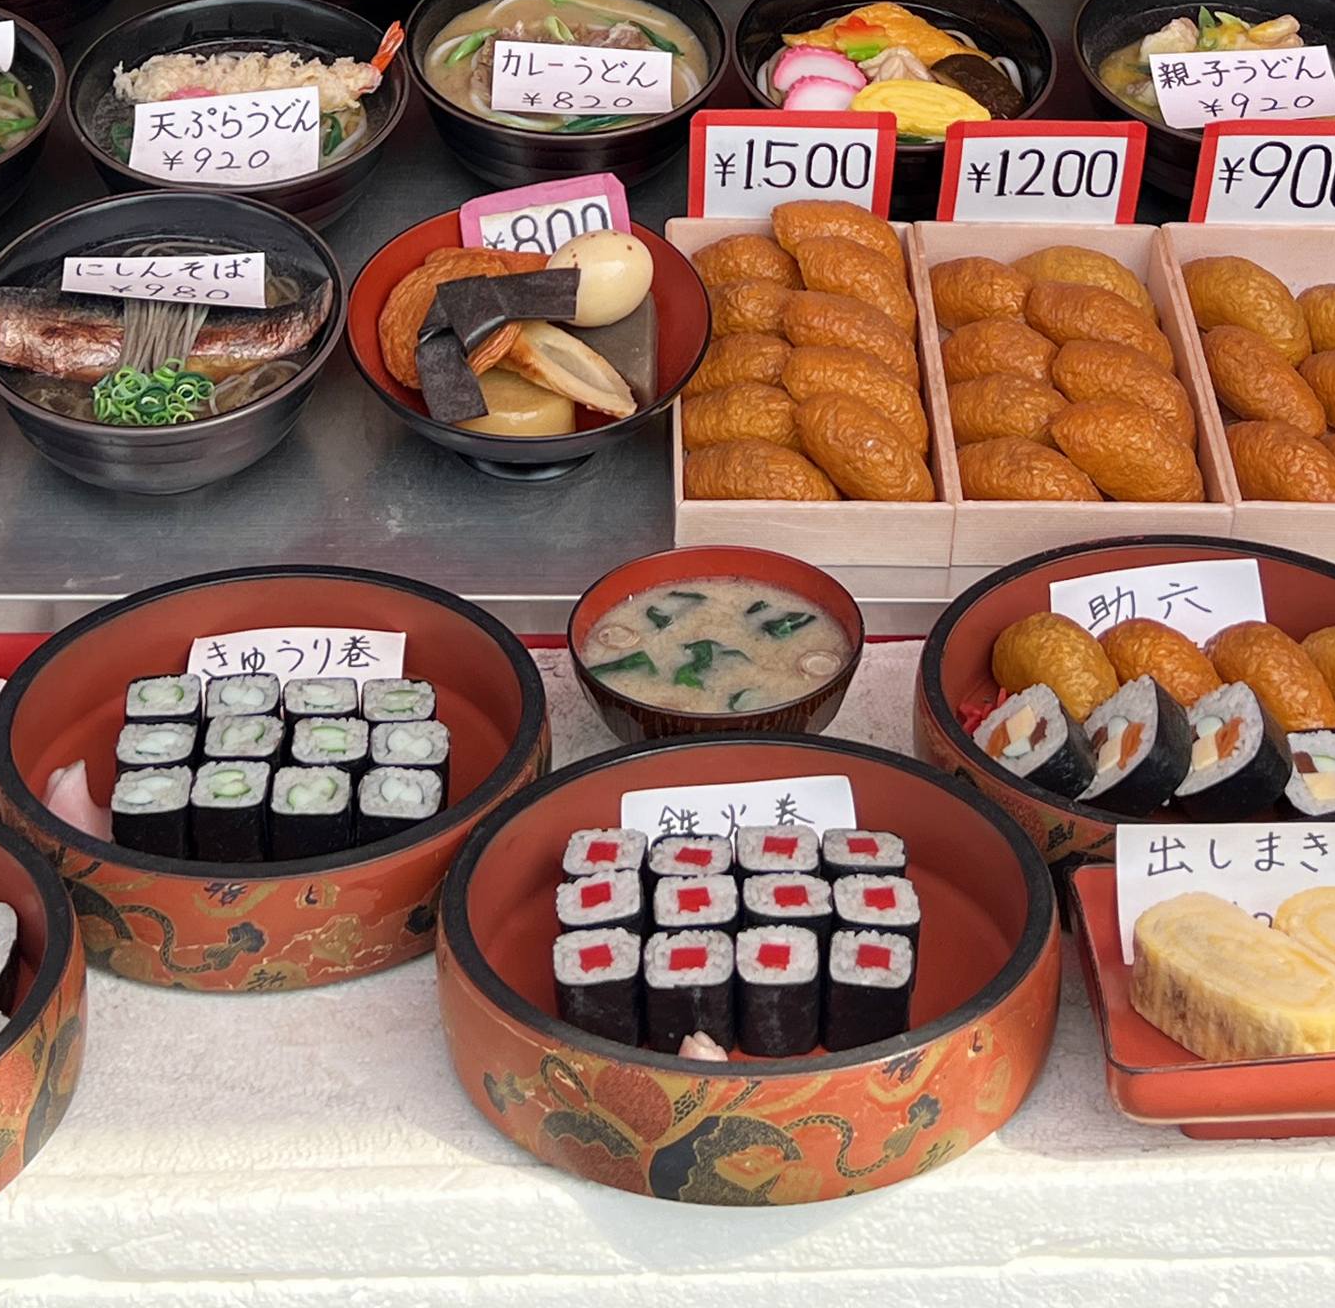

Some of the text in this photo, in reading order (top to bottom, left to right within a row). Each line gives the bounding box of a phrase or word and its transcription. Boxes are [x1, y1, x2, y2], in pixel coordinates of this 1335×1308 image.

[501, 48, 658, 88] カレーうどん
[1158, 55, 1326, 89] 親子うどん
[522, 91, 633, 109] ¥820
[1198, 92, 1314, 118] ¥920
[149, 97, 318, 141] 天ぷらうどん
[162, 147, 270, 173] ¥920
[76, 257, 252, 280] にしんそば
[109, 283, 230, 300] ¥980
[1088, 583, 1212, 630] 助六
[202, 635, 380, 677] きゅうり巻
[1147, 831, 1329, 876] 出しまき
